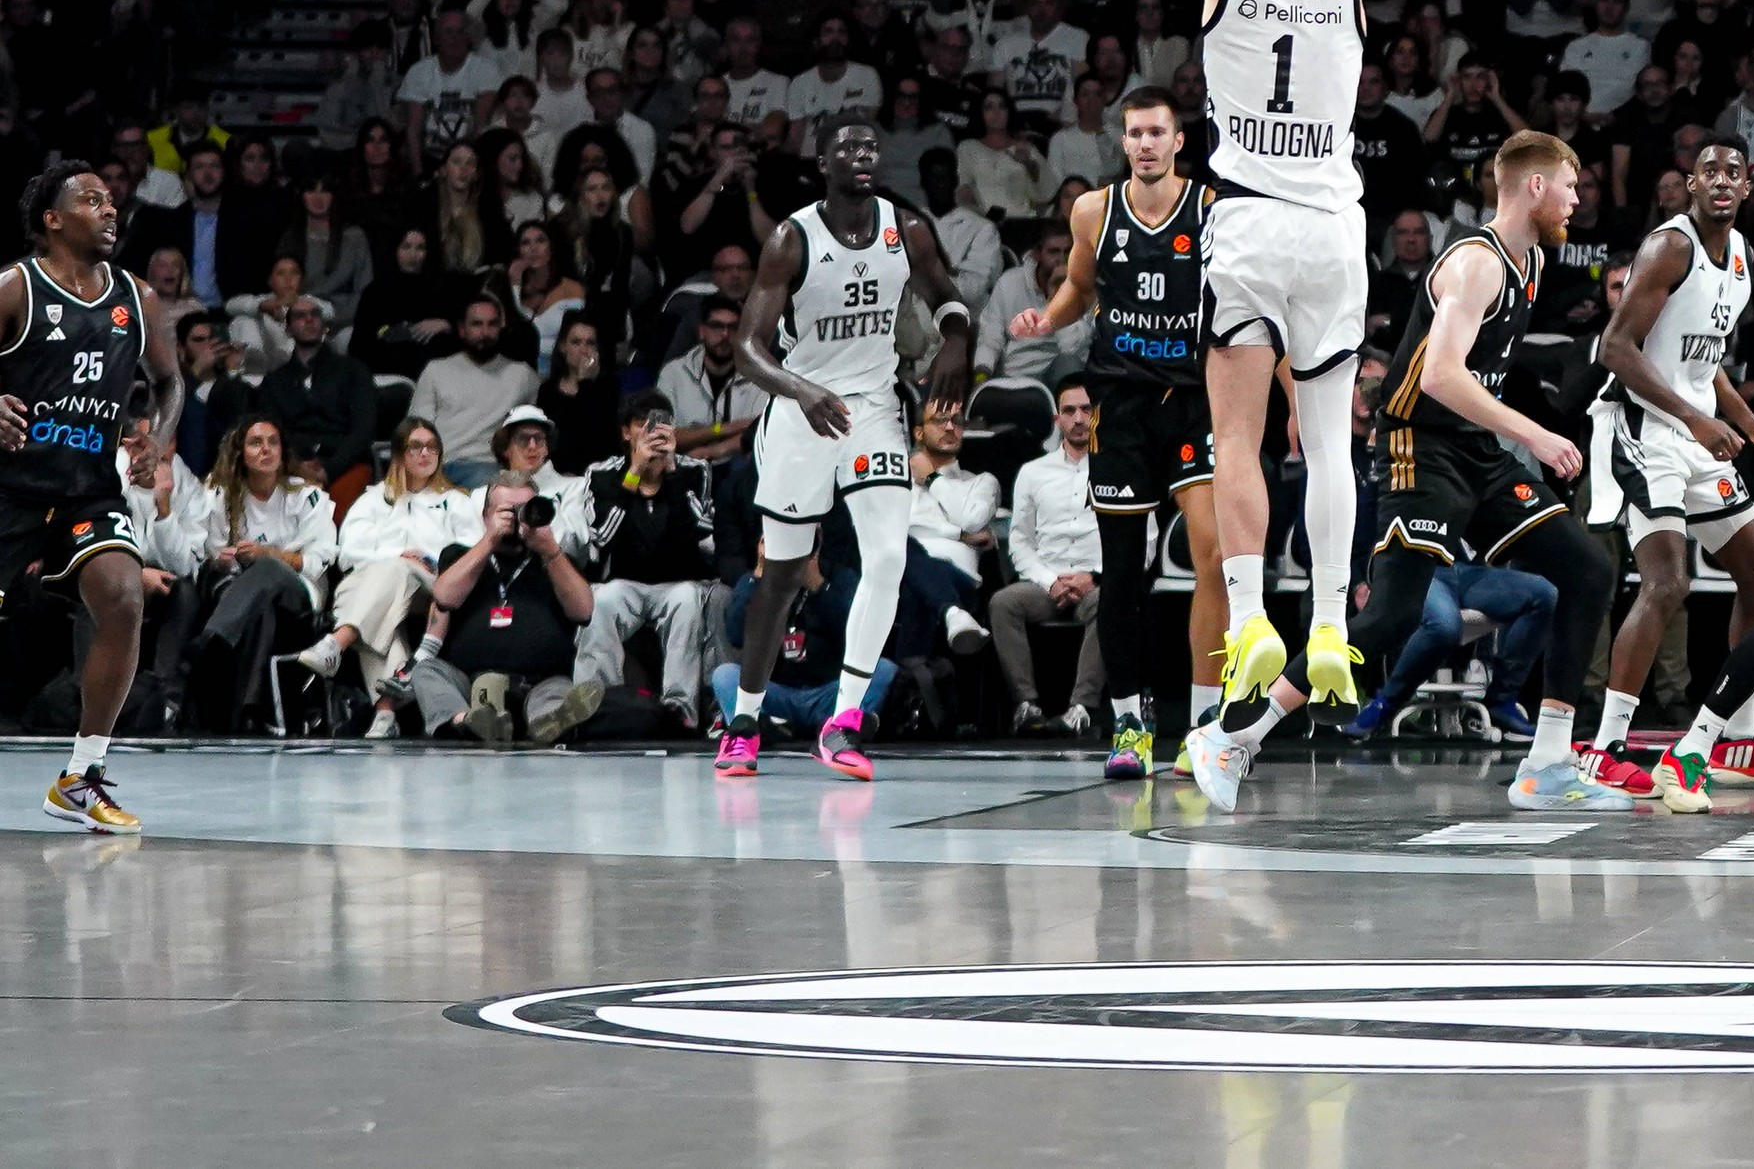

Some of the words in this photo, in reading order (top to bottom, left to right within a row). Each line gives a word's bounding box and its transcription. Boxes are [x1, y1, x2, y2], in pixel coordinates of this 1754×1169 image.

[1264, 4, 1342, 24] Pelliconi
[1266, 34, 1294, 114] 1
[1229, 116, 1334, 159] BOLOGNA
[844, 279, 878, 307] 35
[1137, 271, 1165, 301] 30
[1109, 308, 1197, 330] OMNIYAT
[1115, 332, 1187, 358] dnata
[72, 351, 104, 384] 25
[31, 417, 104, 453] dnata
[872, 451, 904, 477] 35
